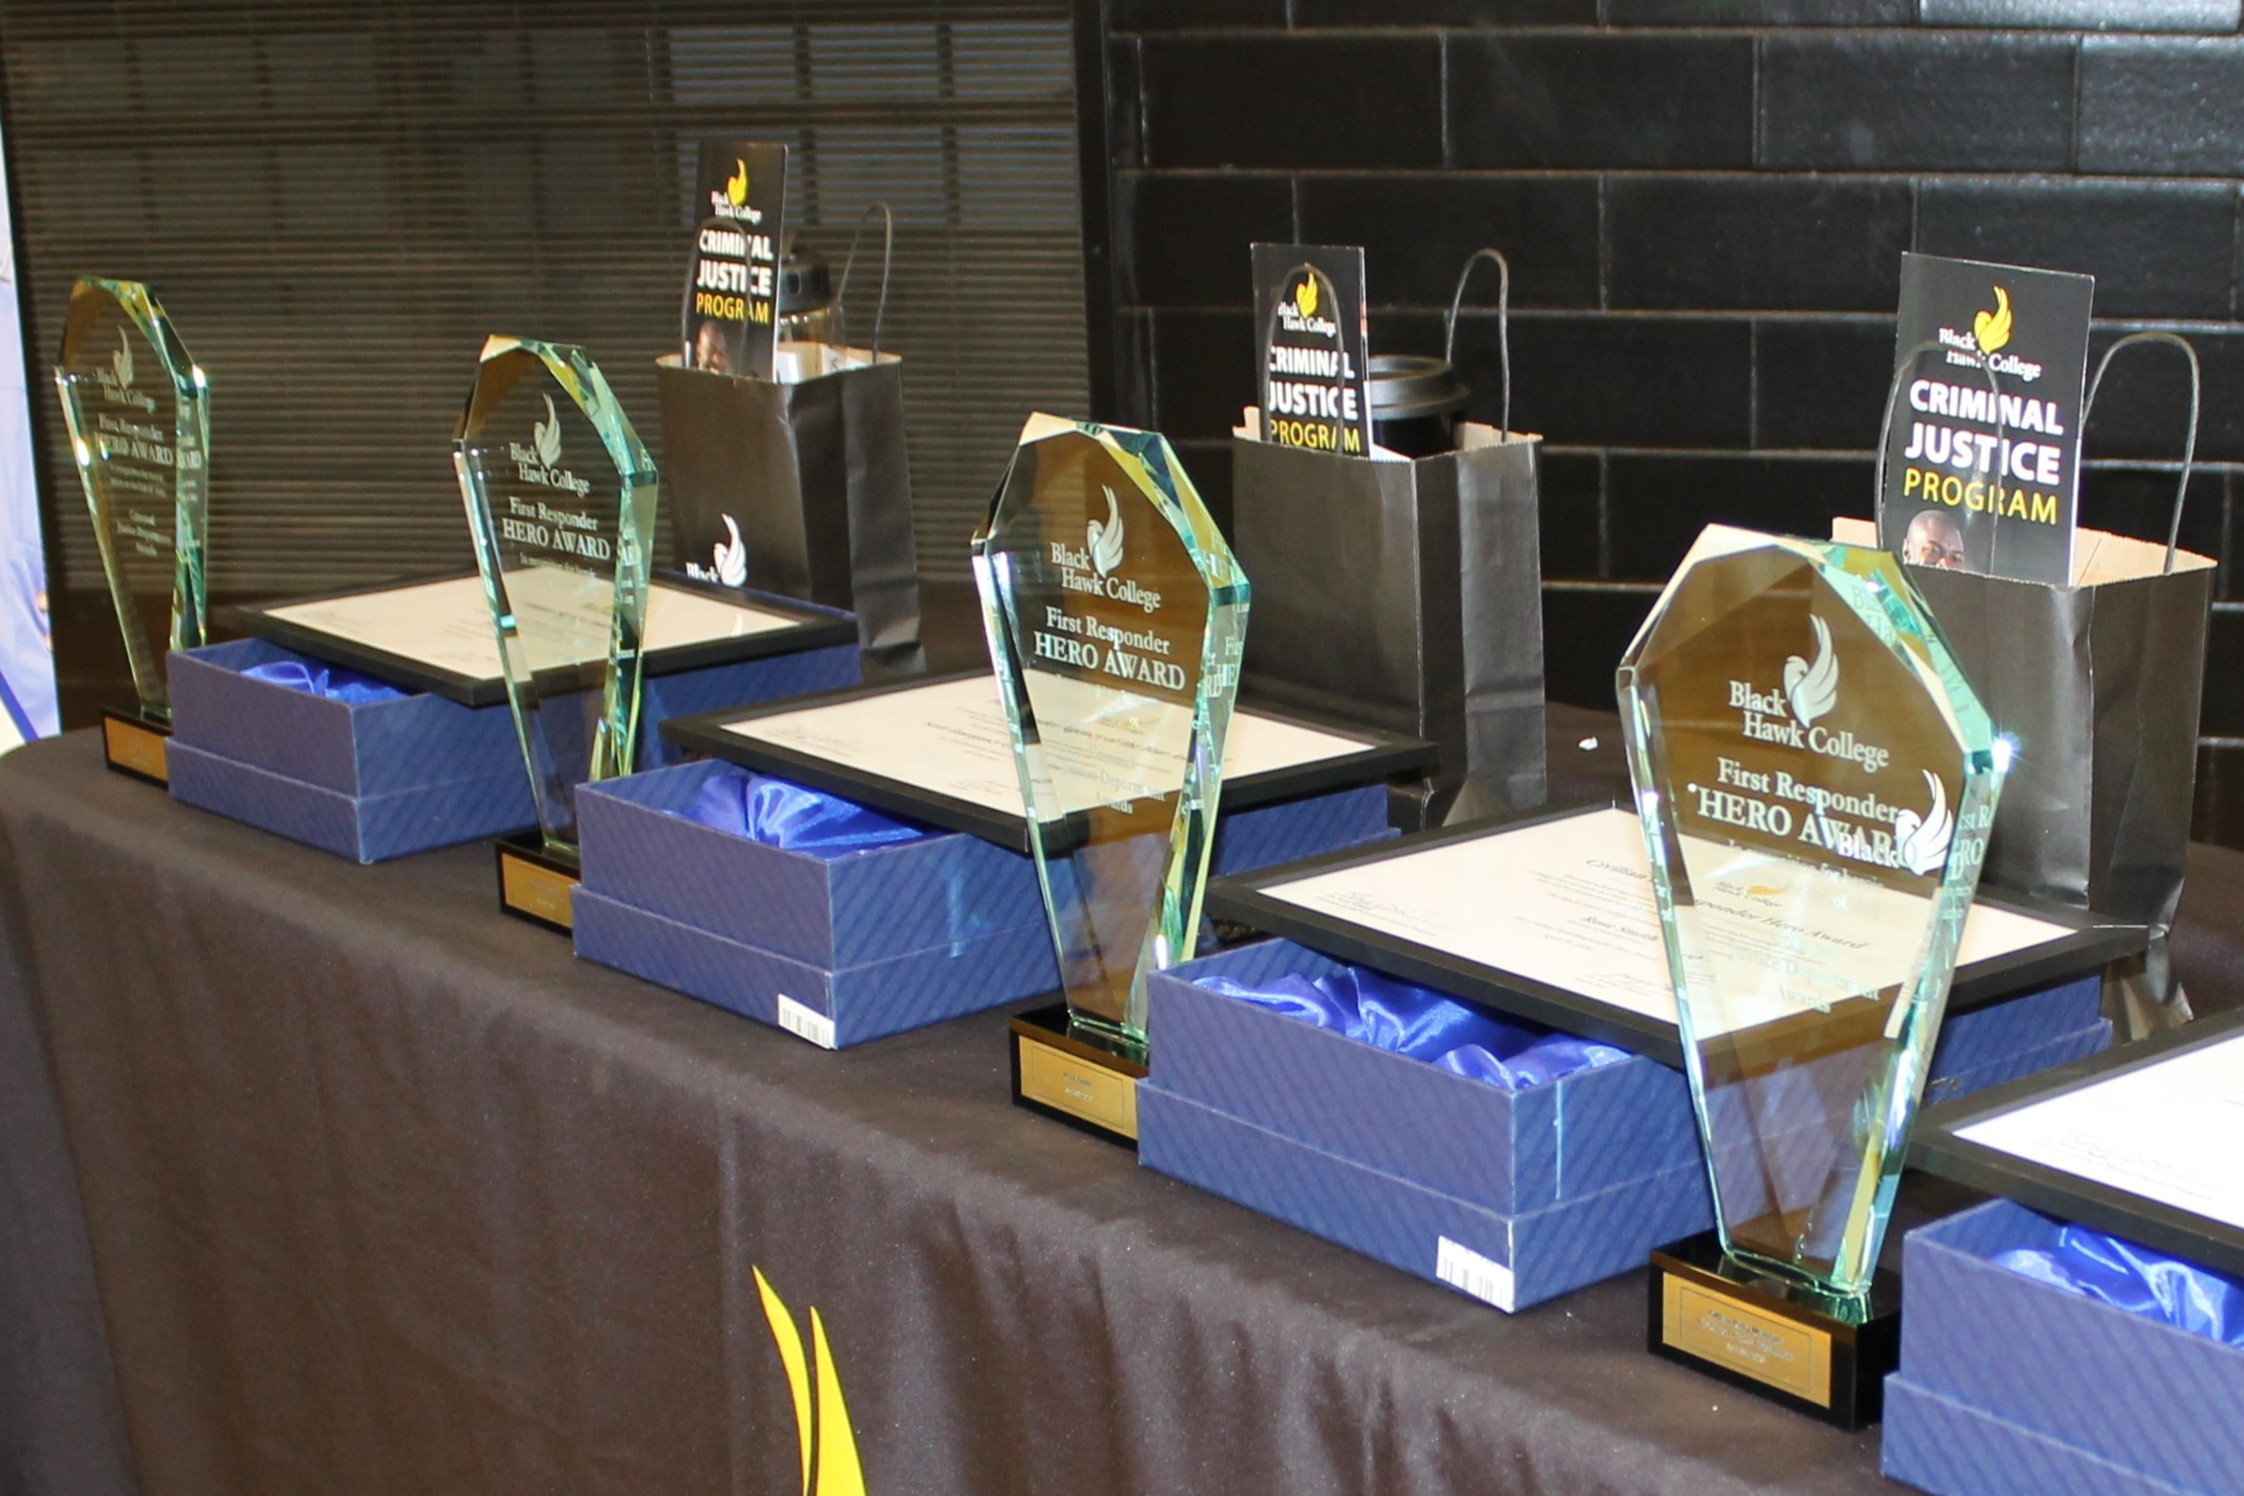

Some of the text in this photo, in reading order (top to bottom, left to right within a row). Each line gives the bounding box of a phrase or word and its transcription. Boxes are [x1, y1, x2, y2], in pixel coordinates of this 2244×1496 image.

[699, 228, 774, 261] CRIMINAL
[696, 259, 772, 297] JUSTICE
[1938, 327, 1976, 351] Black
[1269, 345, 1356, 379] CRIMINAL
[1988, 352, 2043, 382] College
[1268, 380, 1359, 421] JUSTICE
[1908, 379, 2065, 436] CRIMINAL
[131, 438, 174, 467] AWARD
[509, 442, 539, 466] Black
[1903, 422, 2061, 486] JUSTICE
[518, 463, 590, 498] Hawk College
[1902, 467, 2058, 526] PROGRAM
[509, 496, 598, 532] First Responder
[502, 518, 549, 547] HERO
[552, 529, 611, 561] AWARD
[1050, 541, 1090, 572] Black
[1061, 566, 1162, 614] Hawk College
[1046, 605, 1170, 656] First Responder
[1033, 630, 1099, 670] HERO
[1103, 648, 1186, 691] AWARD
[1729, 680, 1787, 717] Black
[1742, 710, 1890, 773] Hawk College
[1717, 756, 1900, 825] First Responder
[1697, 786, 1793, 837] HERO
[1797, 812, 1917, 867] AWARD
[1837, 831, 1901, 869] Black
